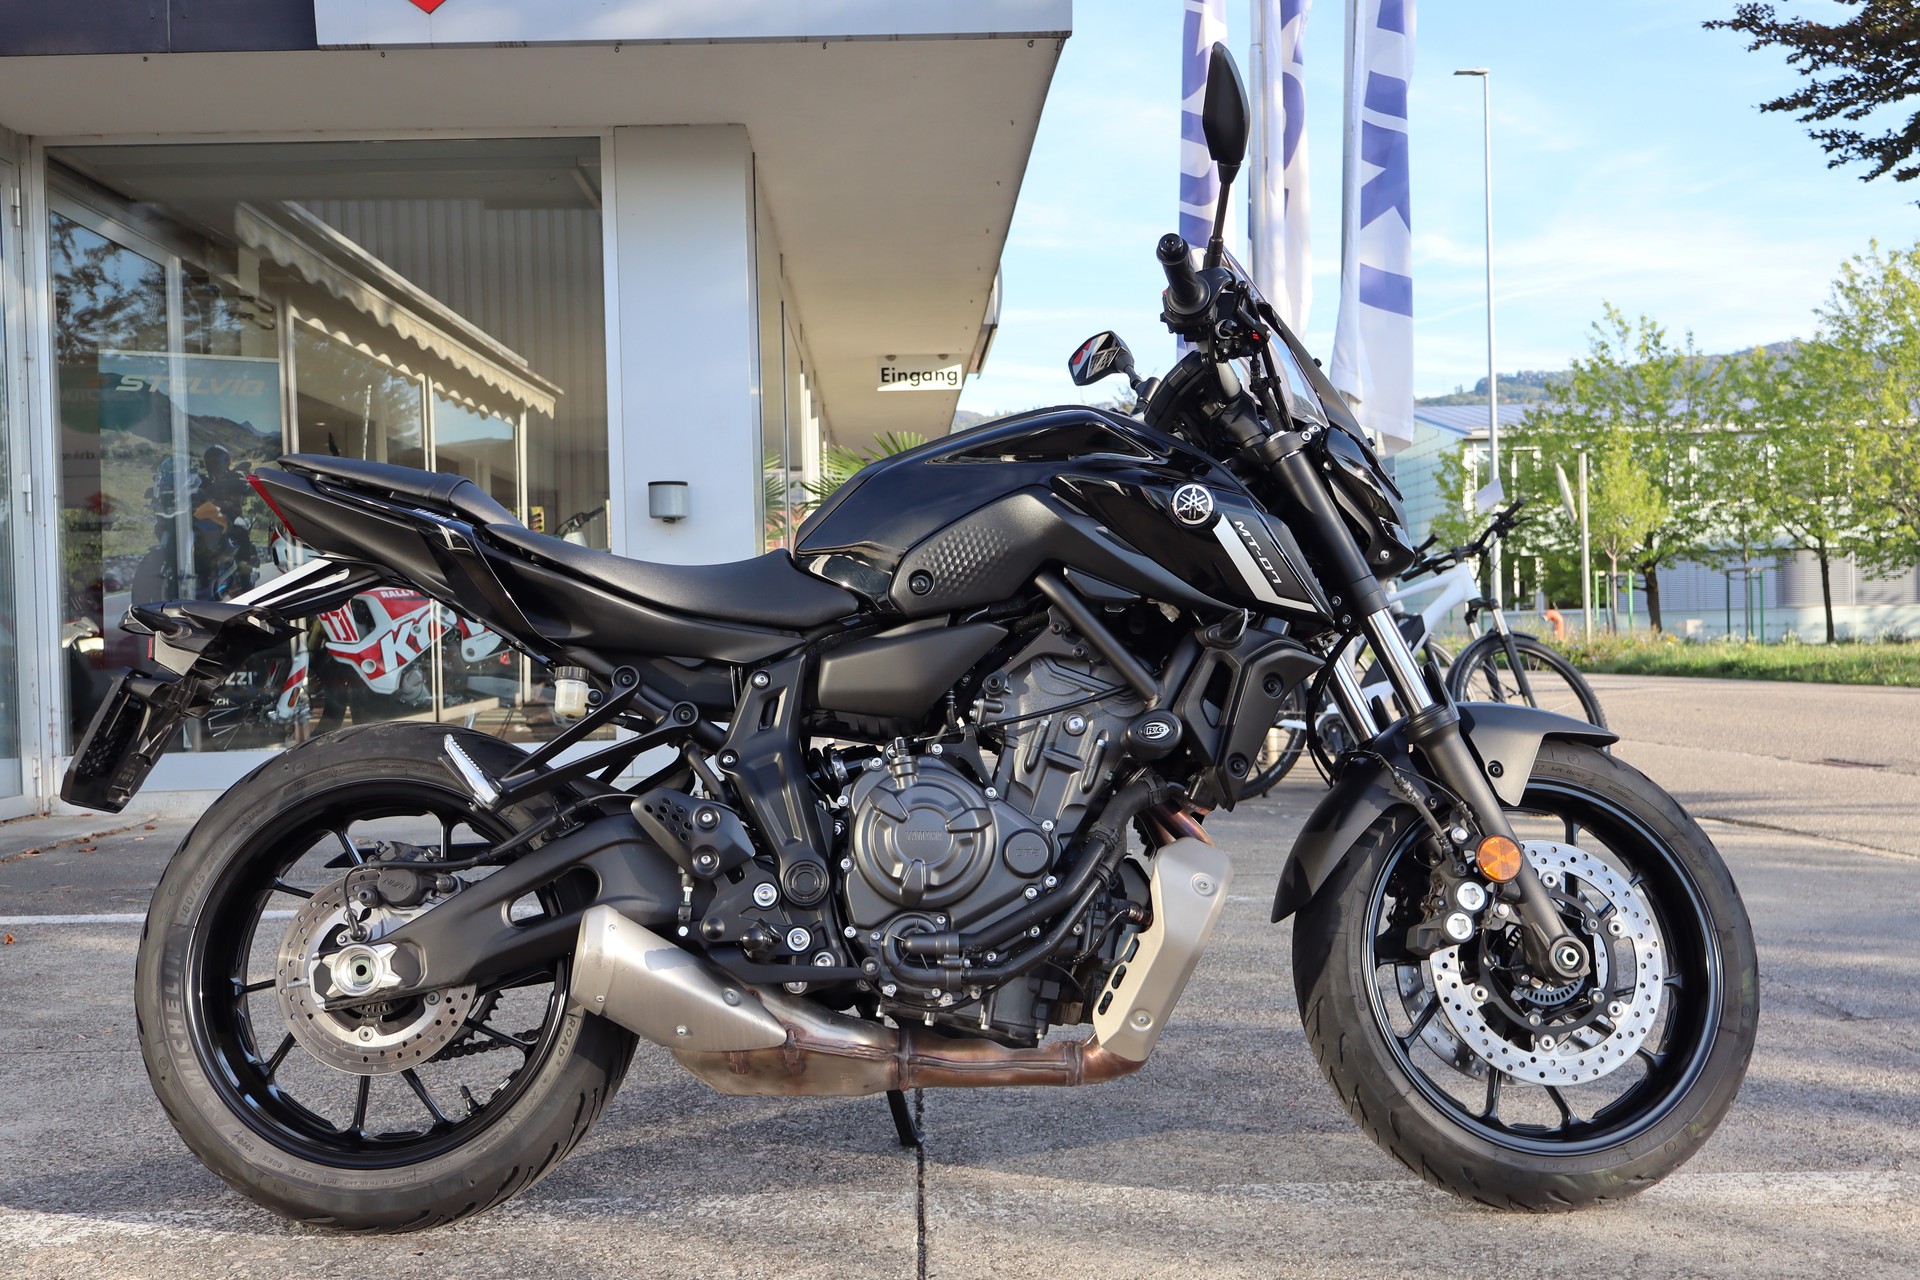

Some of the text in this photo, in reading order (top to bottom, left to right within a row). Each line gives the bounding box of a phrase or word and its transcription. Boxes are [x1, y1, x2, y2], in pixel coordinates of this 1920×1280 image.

[116, 374, 265, 396] STELVIO
[881, 367, 957, 386] Eingang
[1234, 521, 1282, 583] MT-07
[380, 589, 415, 599] RALLY
[1146, 726, 1165, 735] R&G
[905, 830, 943, 841] YAMAHA
[162, 940, 201, 1089] MICHELIN
[558, 1018, 576, 1057] ROAD
